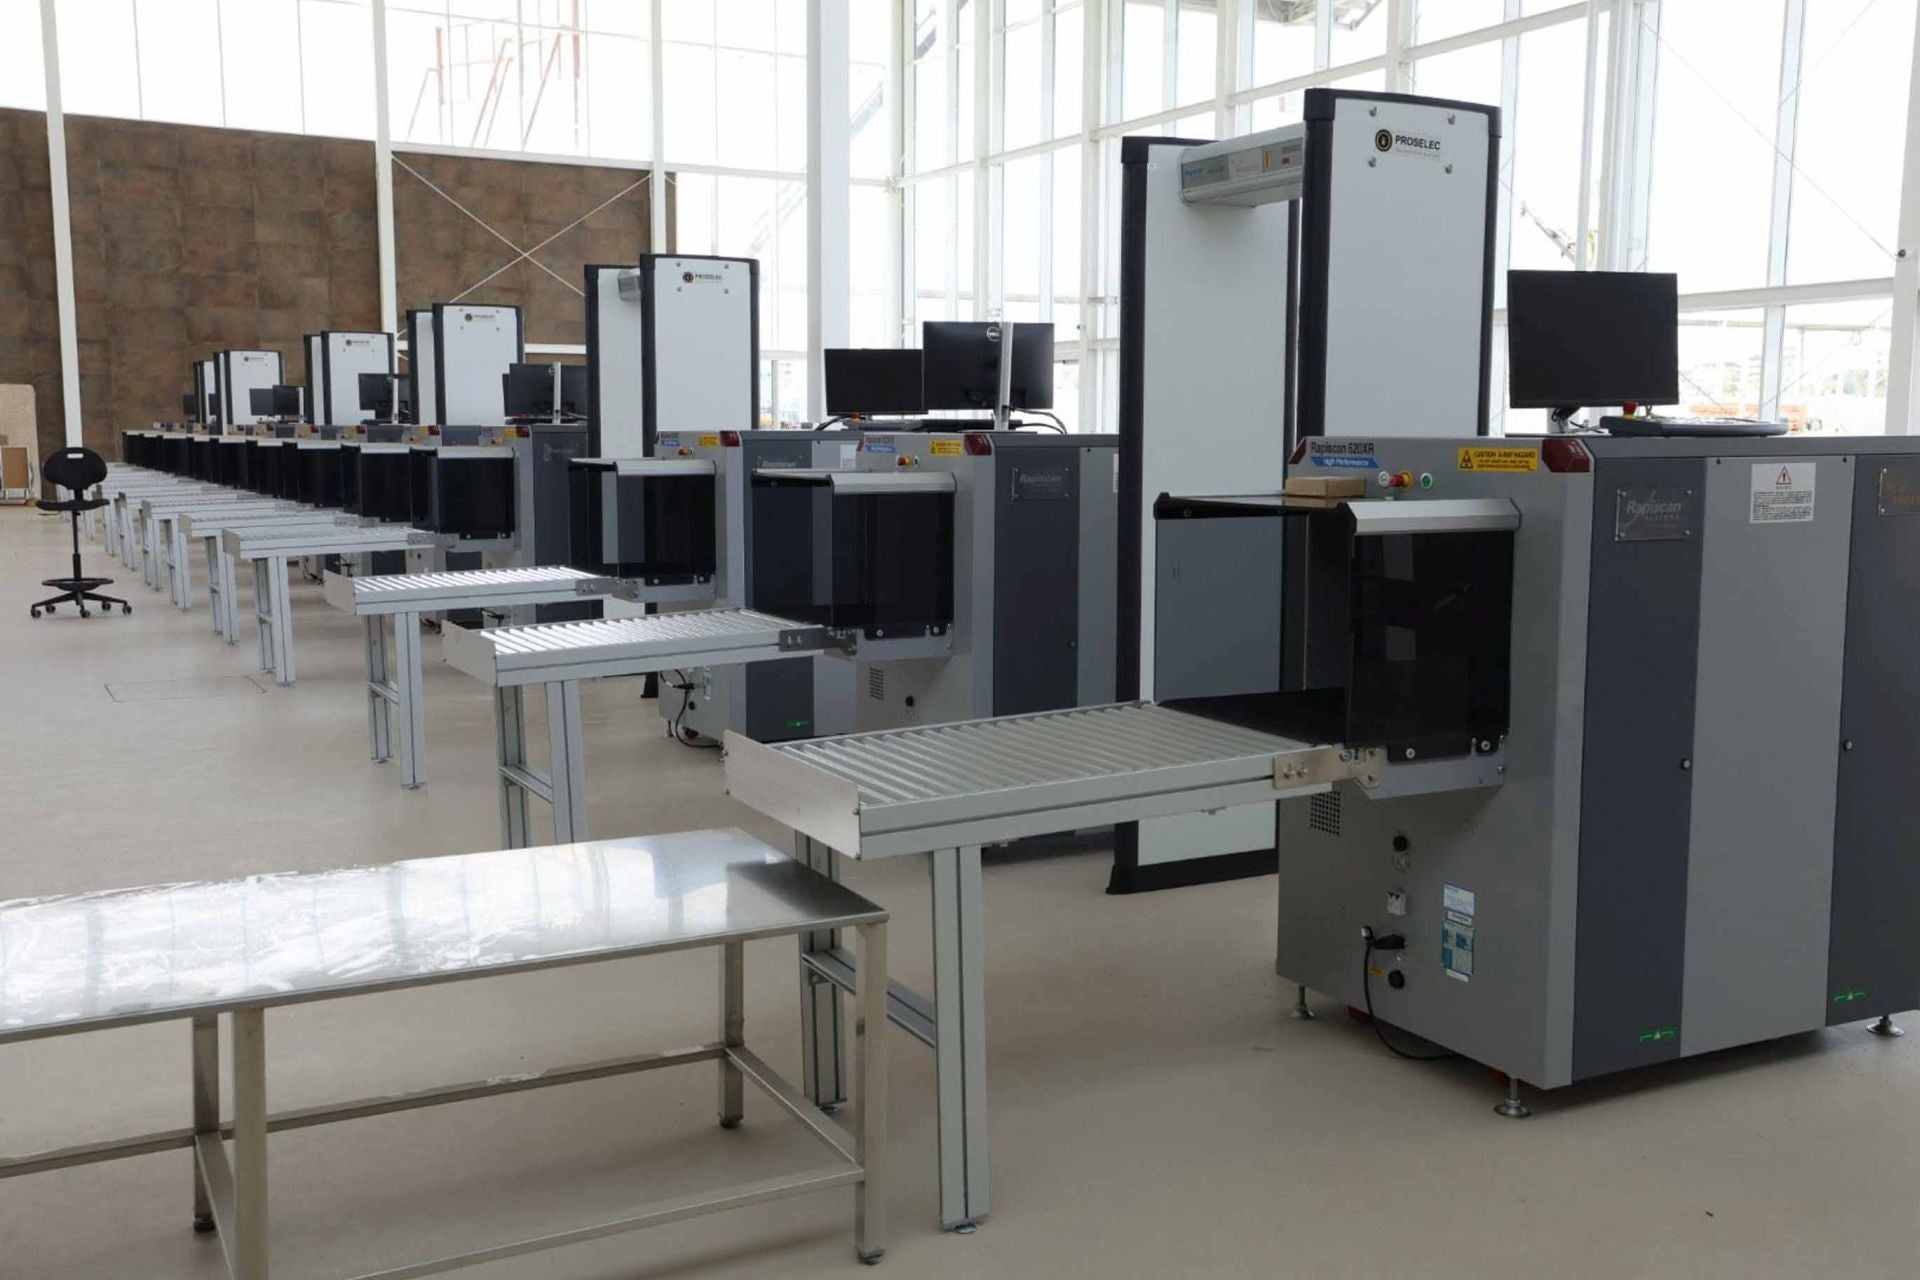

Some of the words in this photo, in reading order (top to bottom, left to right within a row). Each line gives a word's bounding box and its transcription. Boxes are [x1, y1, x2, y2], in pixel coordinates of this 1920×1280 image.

[1395, 134, 1441, 150] PROSELEC
[1311, 441, 1347, 455] Rapiscan
[1626, 500, 1683, 517] Rapiscan
